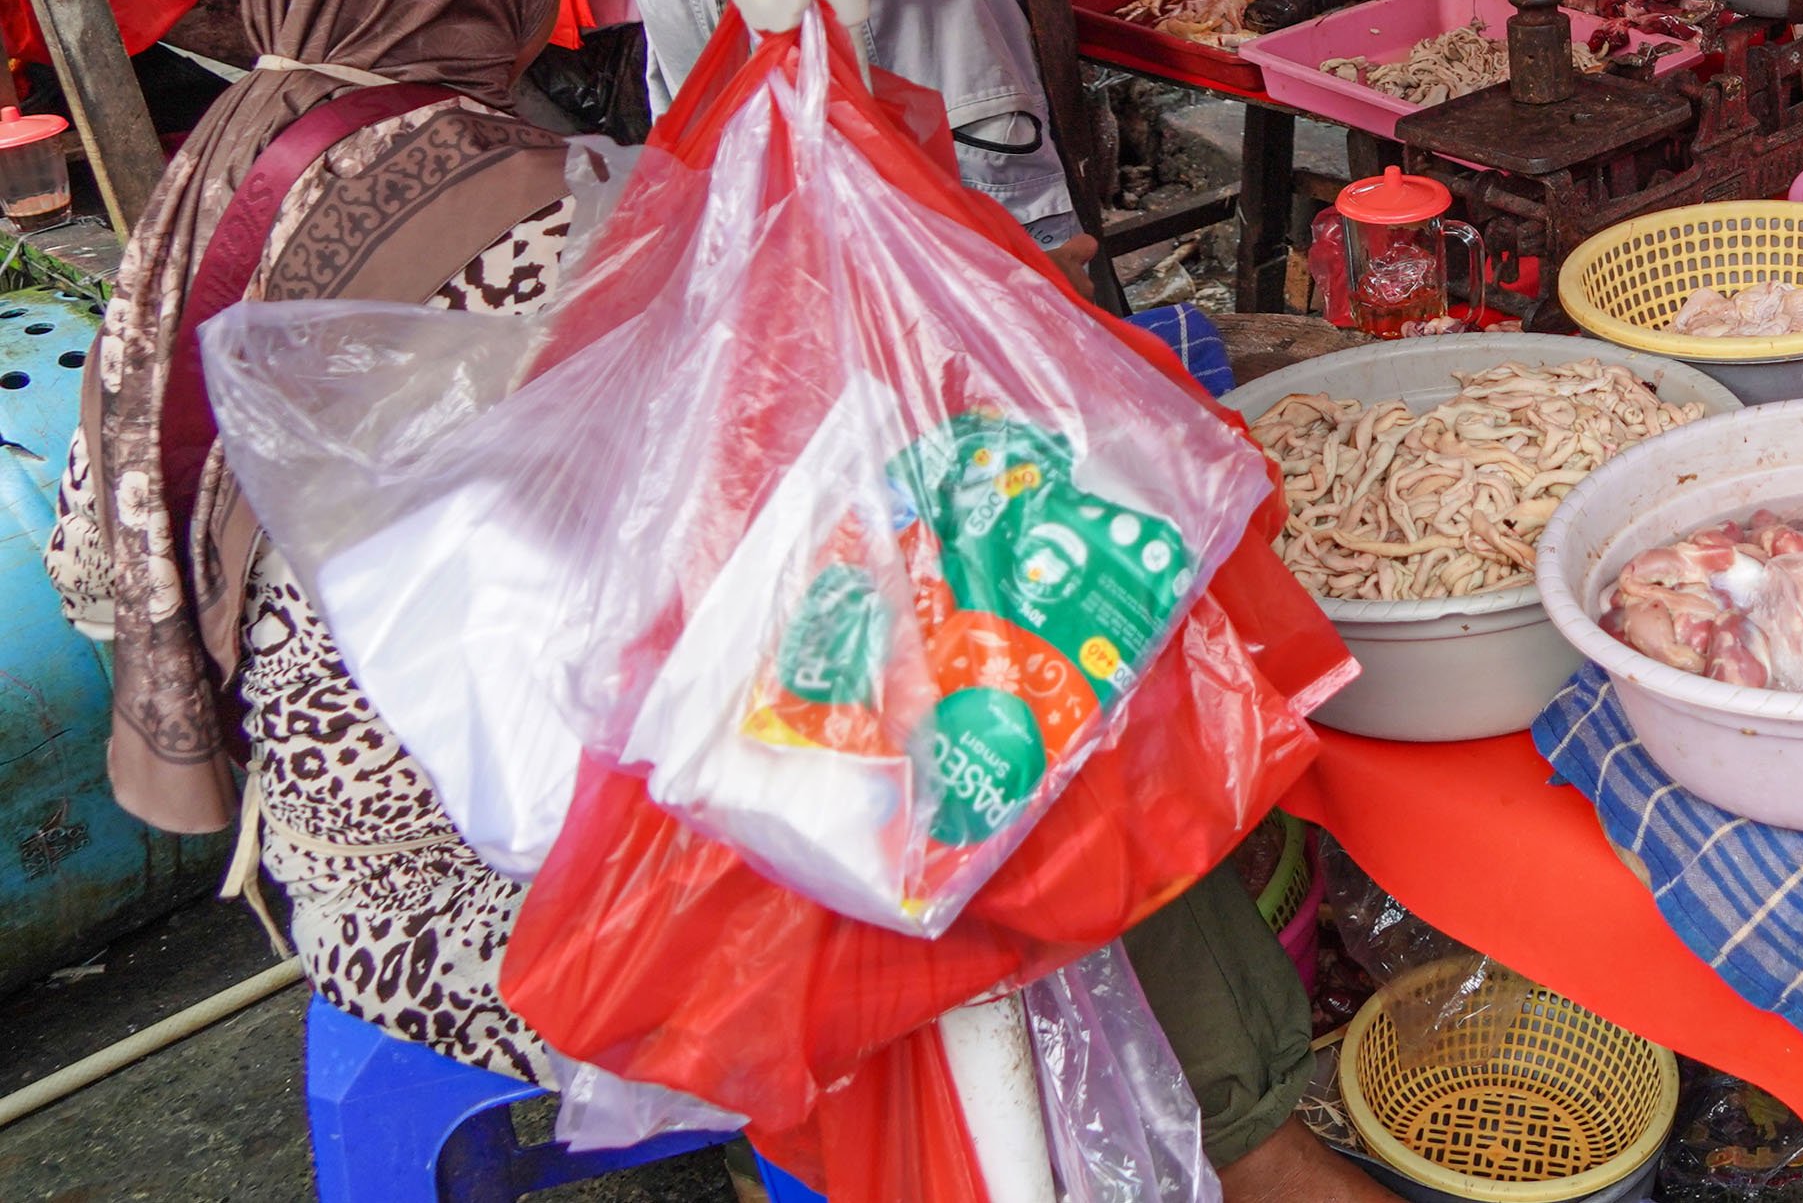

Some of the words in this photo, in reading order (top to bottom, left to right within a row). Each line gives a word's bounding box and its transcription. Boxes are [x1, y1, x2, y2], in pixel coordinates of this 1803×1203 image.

[1087, 642, 1115, 668] +40
[959, 729, 1011, 779] Smart
[932, 731, 1018, 830] PASEO
